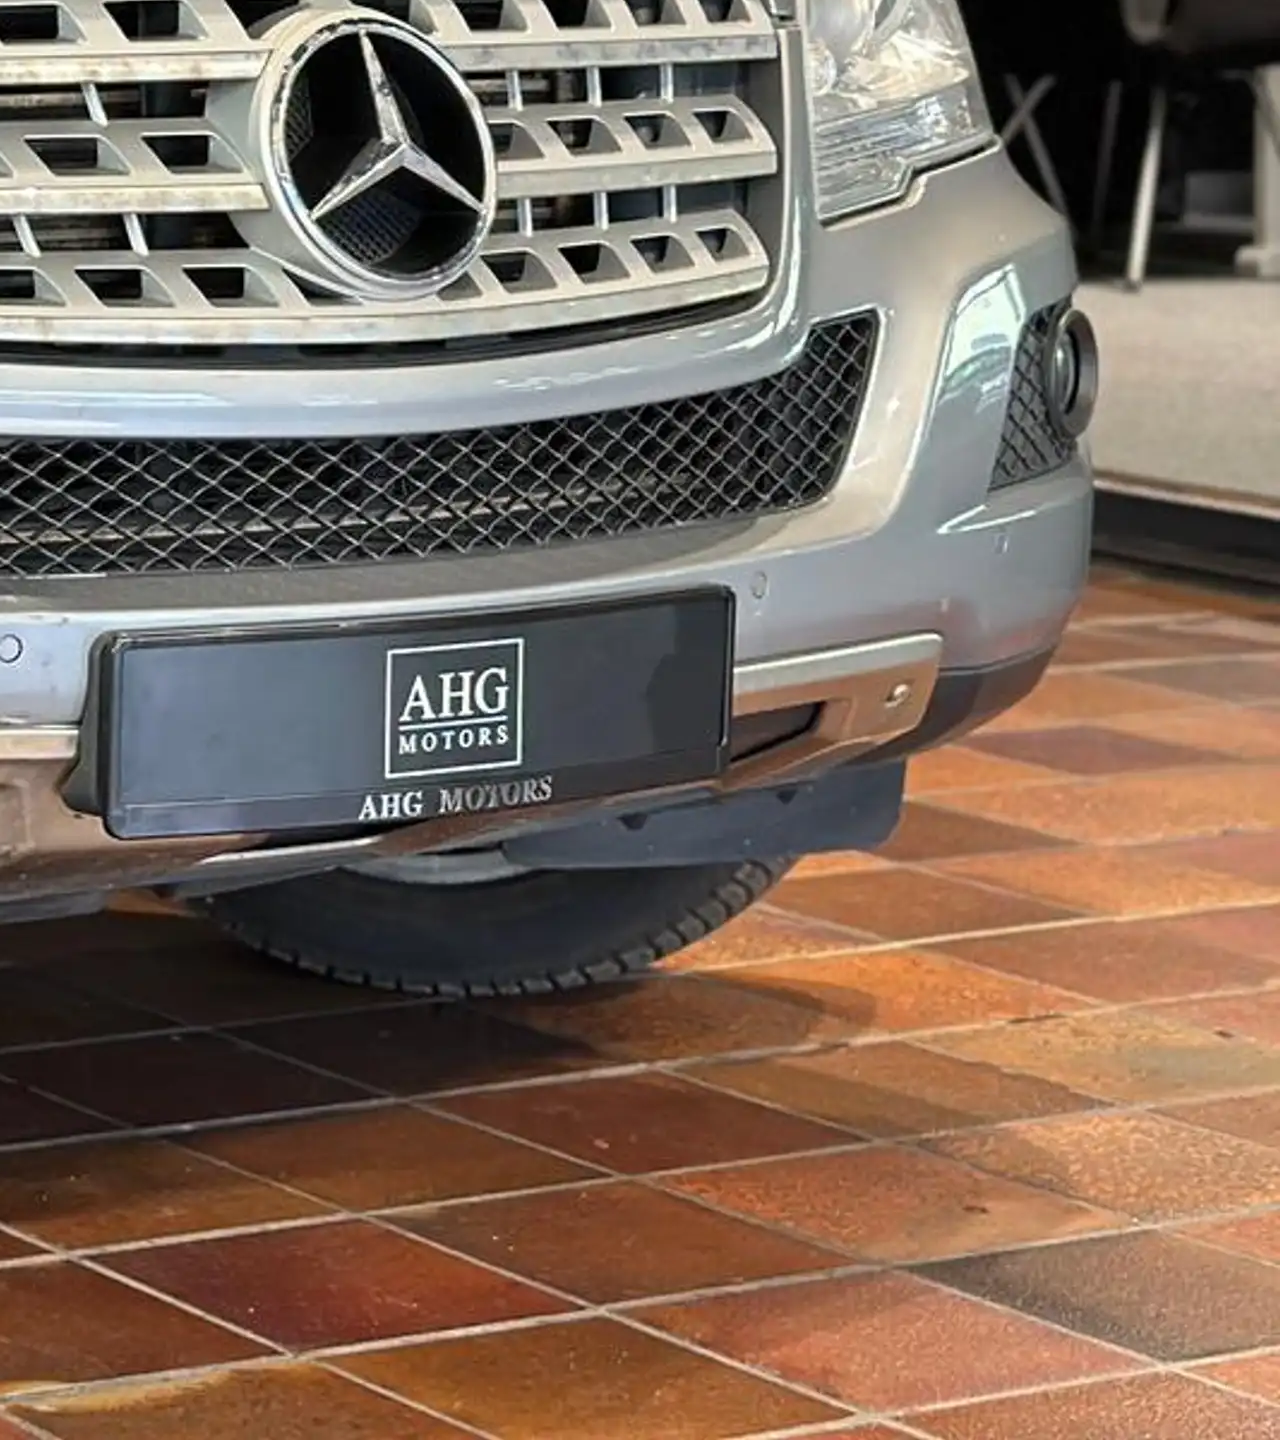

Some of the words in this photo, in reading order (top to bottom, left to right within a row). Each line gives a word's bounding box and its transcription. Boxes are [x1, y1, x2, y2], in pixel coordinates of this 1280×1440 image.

[398, 666, 509, 722] AHG
[398, 724, 509, 755] MOTORS
[358, 791, 424, 821] AHG
[438, 775, 553, 814] MOTORS
